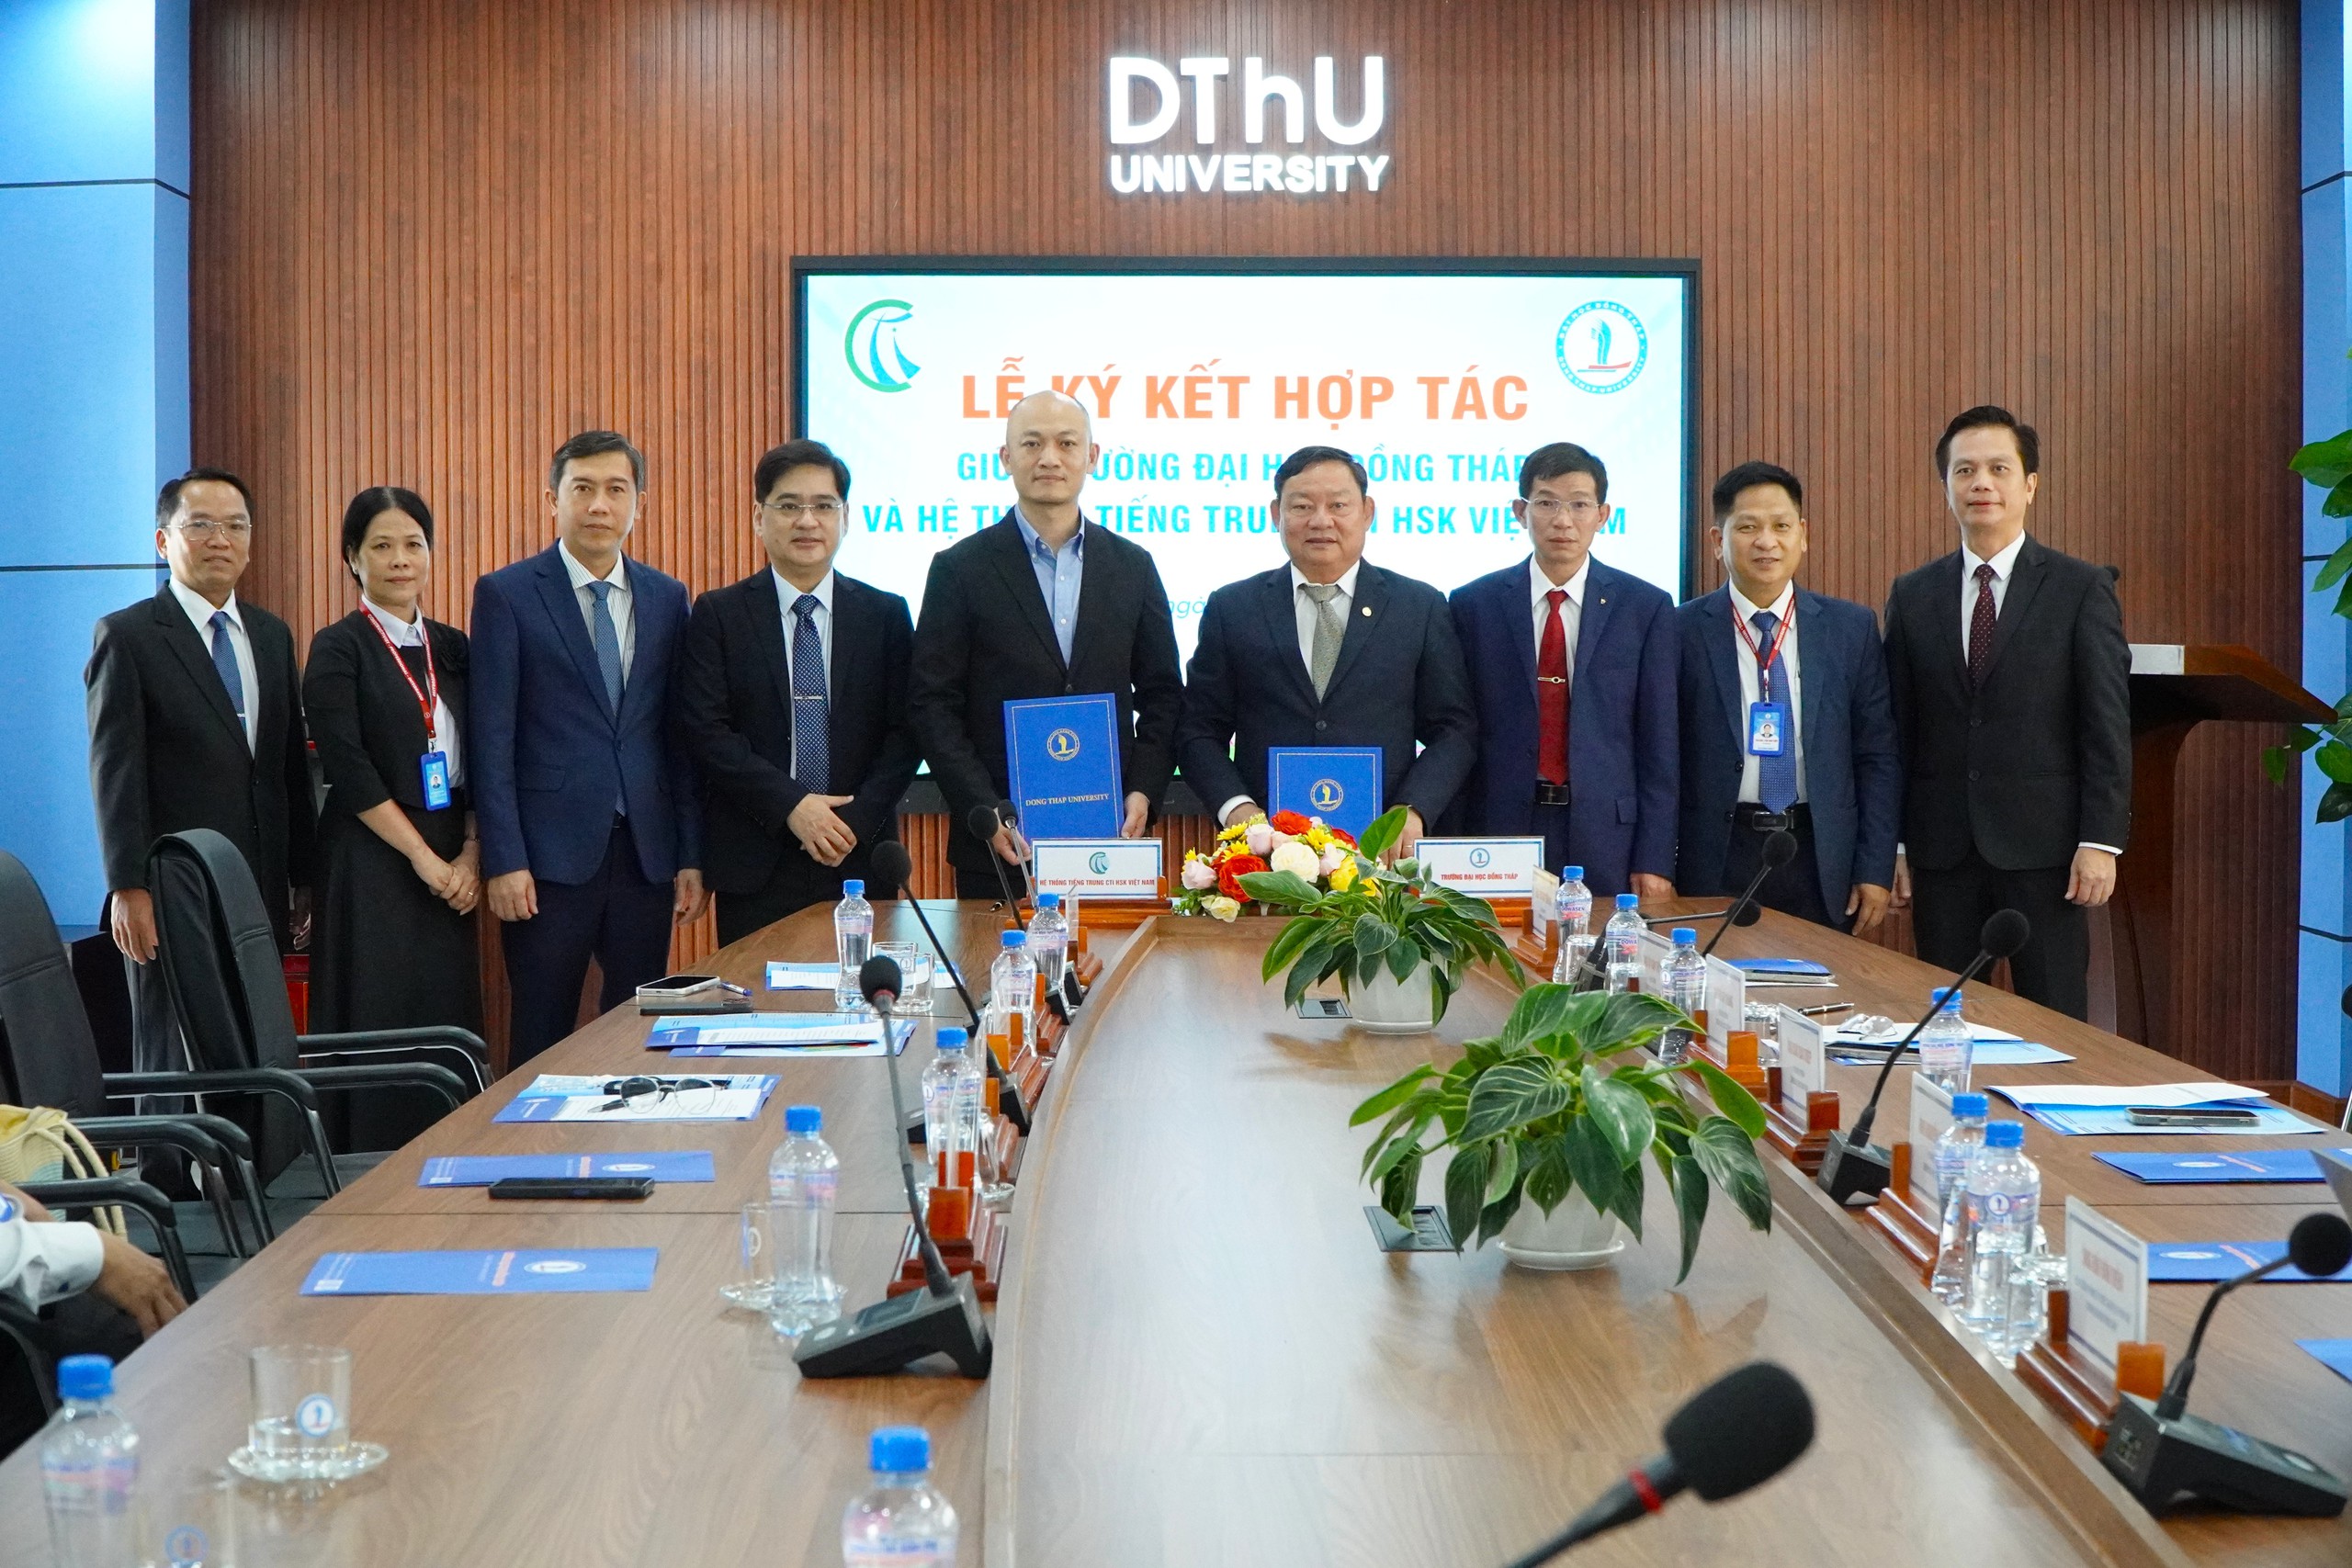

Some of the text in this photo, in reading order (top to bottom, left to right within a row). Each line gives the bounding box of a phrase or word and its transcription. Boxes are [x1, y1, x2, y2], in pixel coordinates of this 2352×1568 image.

[1110, 56, 1384, 145] DThU
[1111, 154, 1389, 193] UNIVERSITY
[962, 356, 1024, 419] LỄ
[1146, 358, 1250, 419] KẾT
[1274, 369, 1394, 431] HỢP
[1417, 365, 1528, 421] TÁC
[1193, 453, 1248, 488] ĐẠI
[1357, 444, 1433, 481] ỒNG
[863, 498, 904, 533] VÀ
[919, 498, 958, 540] HỆ
[1095, 494, 1190, 533] TIẾNG
[1204, 506, 1279, 534] TRU
[1393, 506, 1456, 534] HSK
[1469, 500, 1521, 541] VIỆ
[1025, 794, 1110, 807] DONG THAP UNIVERSITY
[1128, 878, 1140, 886] VIỆT
[1441, 873, 1463, 881] TRƯỜNG
